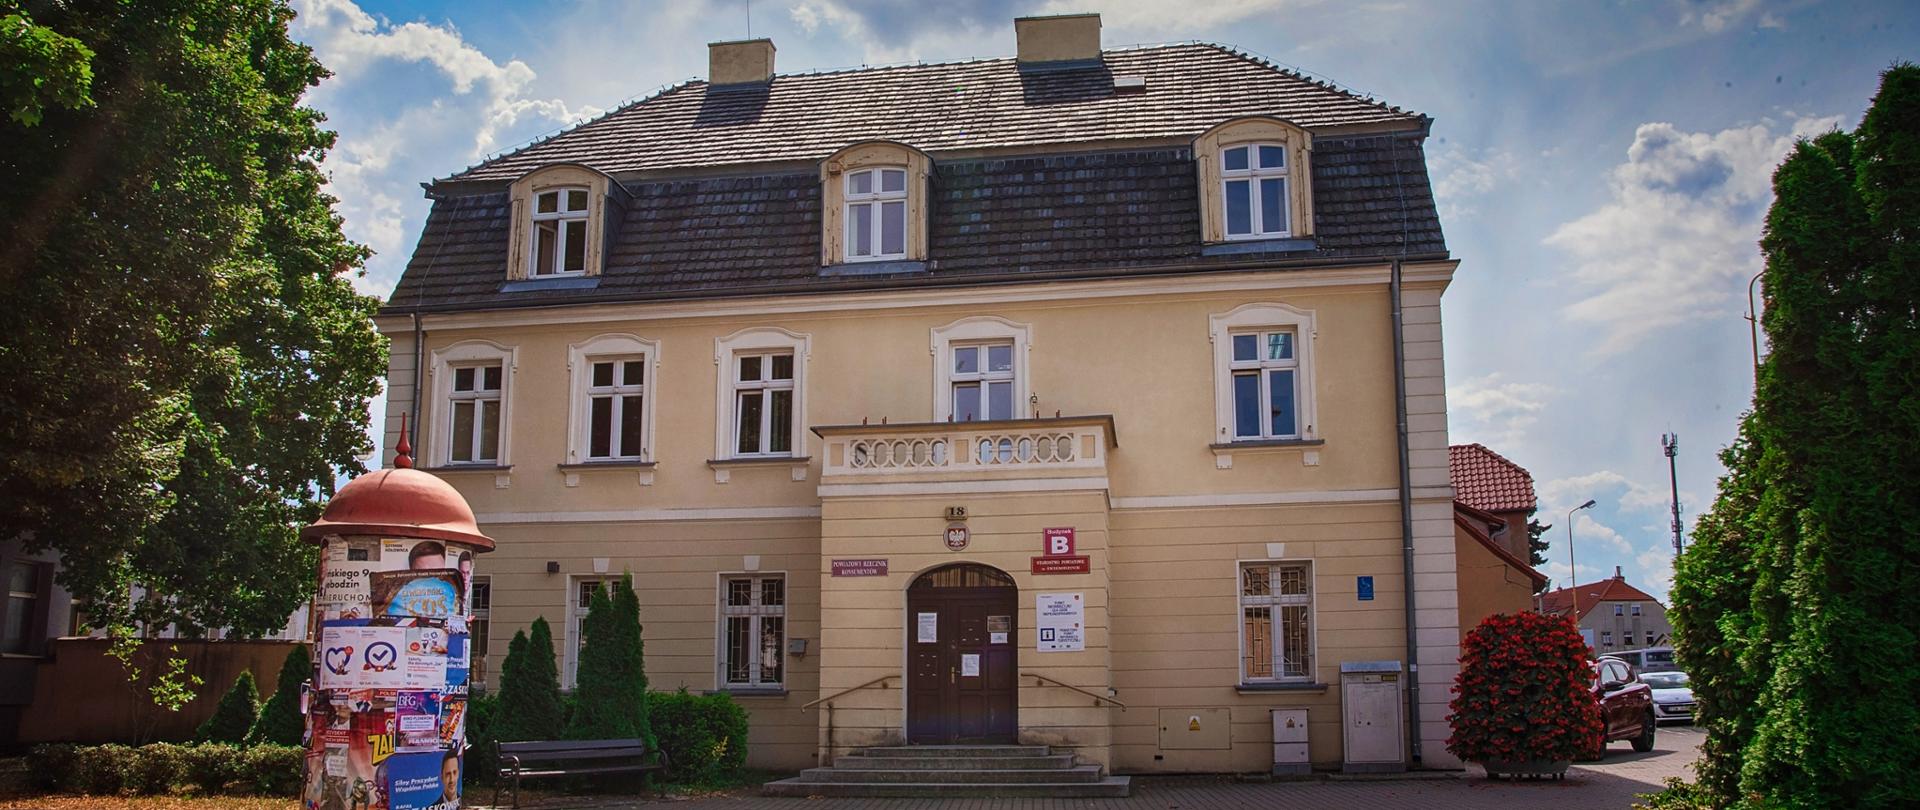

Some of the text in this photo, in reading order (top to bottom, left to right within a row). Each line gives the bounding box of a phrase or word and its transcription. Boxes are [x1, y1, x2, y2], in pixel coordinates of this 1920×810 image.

[950, 507, 965, 516] 18
[1051, 536, 1069, 554] B
[411, 776, 438, 784] Prezydent
